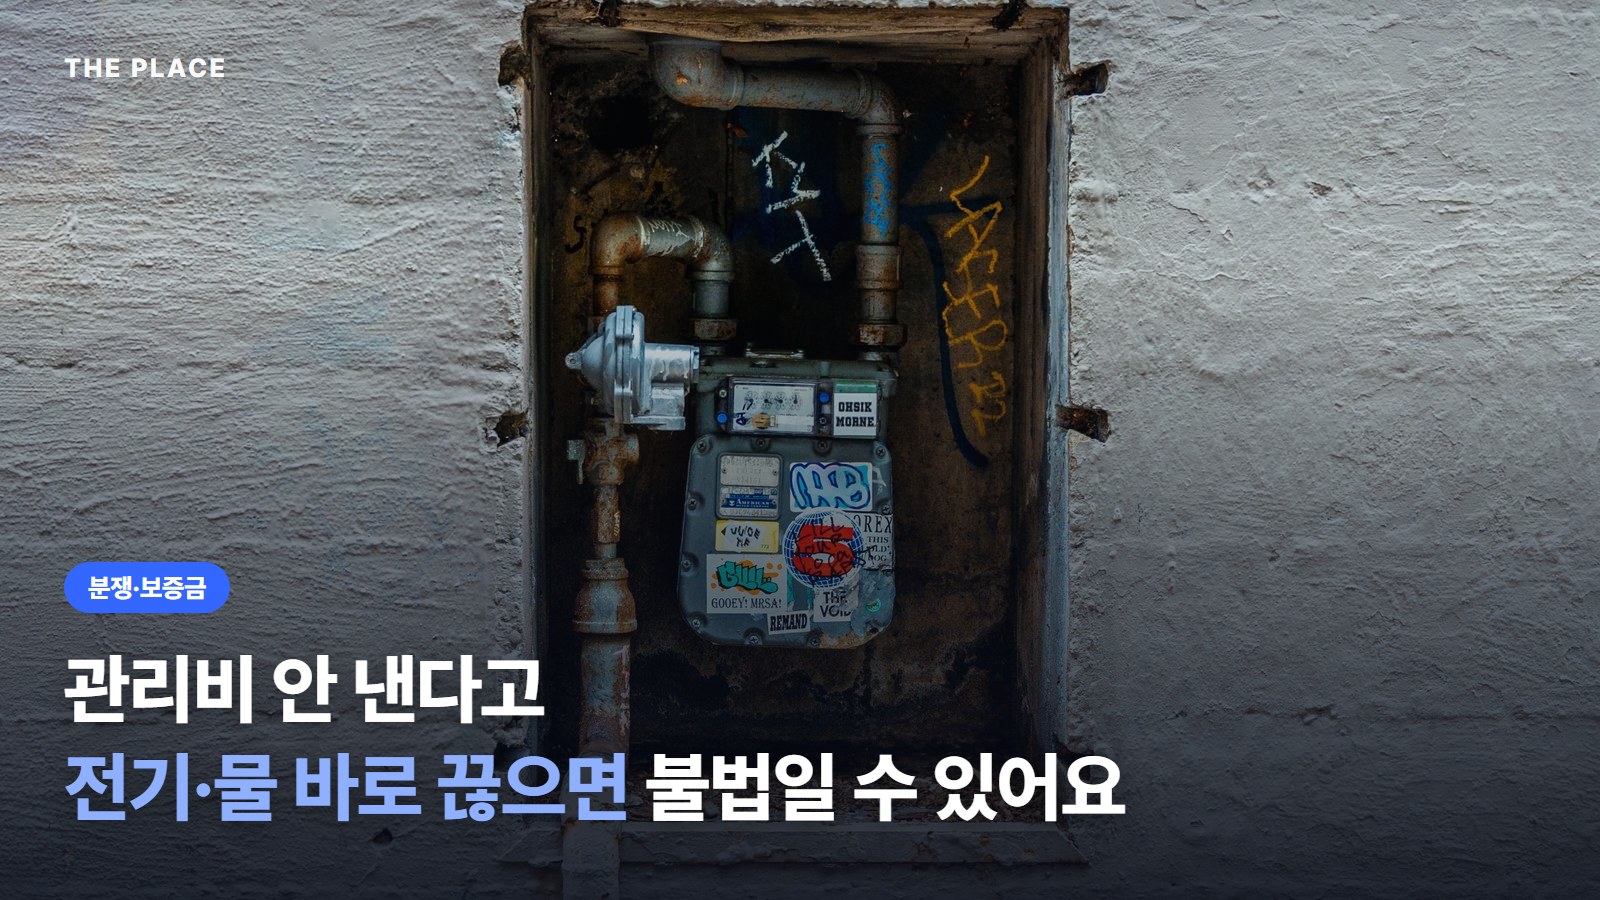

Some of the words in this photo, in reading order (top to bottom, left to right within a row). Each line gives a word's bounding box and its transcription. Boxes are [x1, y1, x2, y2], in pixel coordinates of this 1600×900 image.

[838, 402, 872, 413] OHSIK
[836, 417, 874, 428] MORNE
[867, 536, 889, 544] THIS
[711, 597, 748, 609] GOOEY!
[751, 598, 782, 609] MRSA!
[770, 614, 808, 631] REMAND
